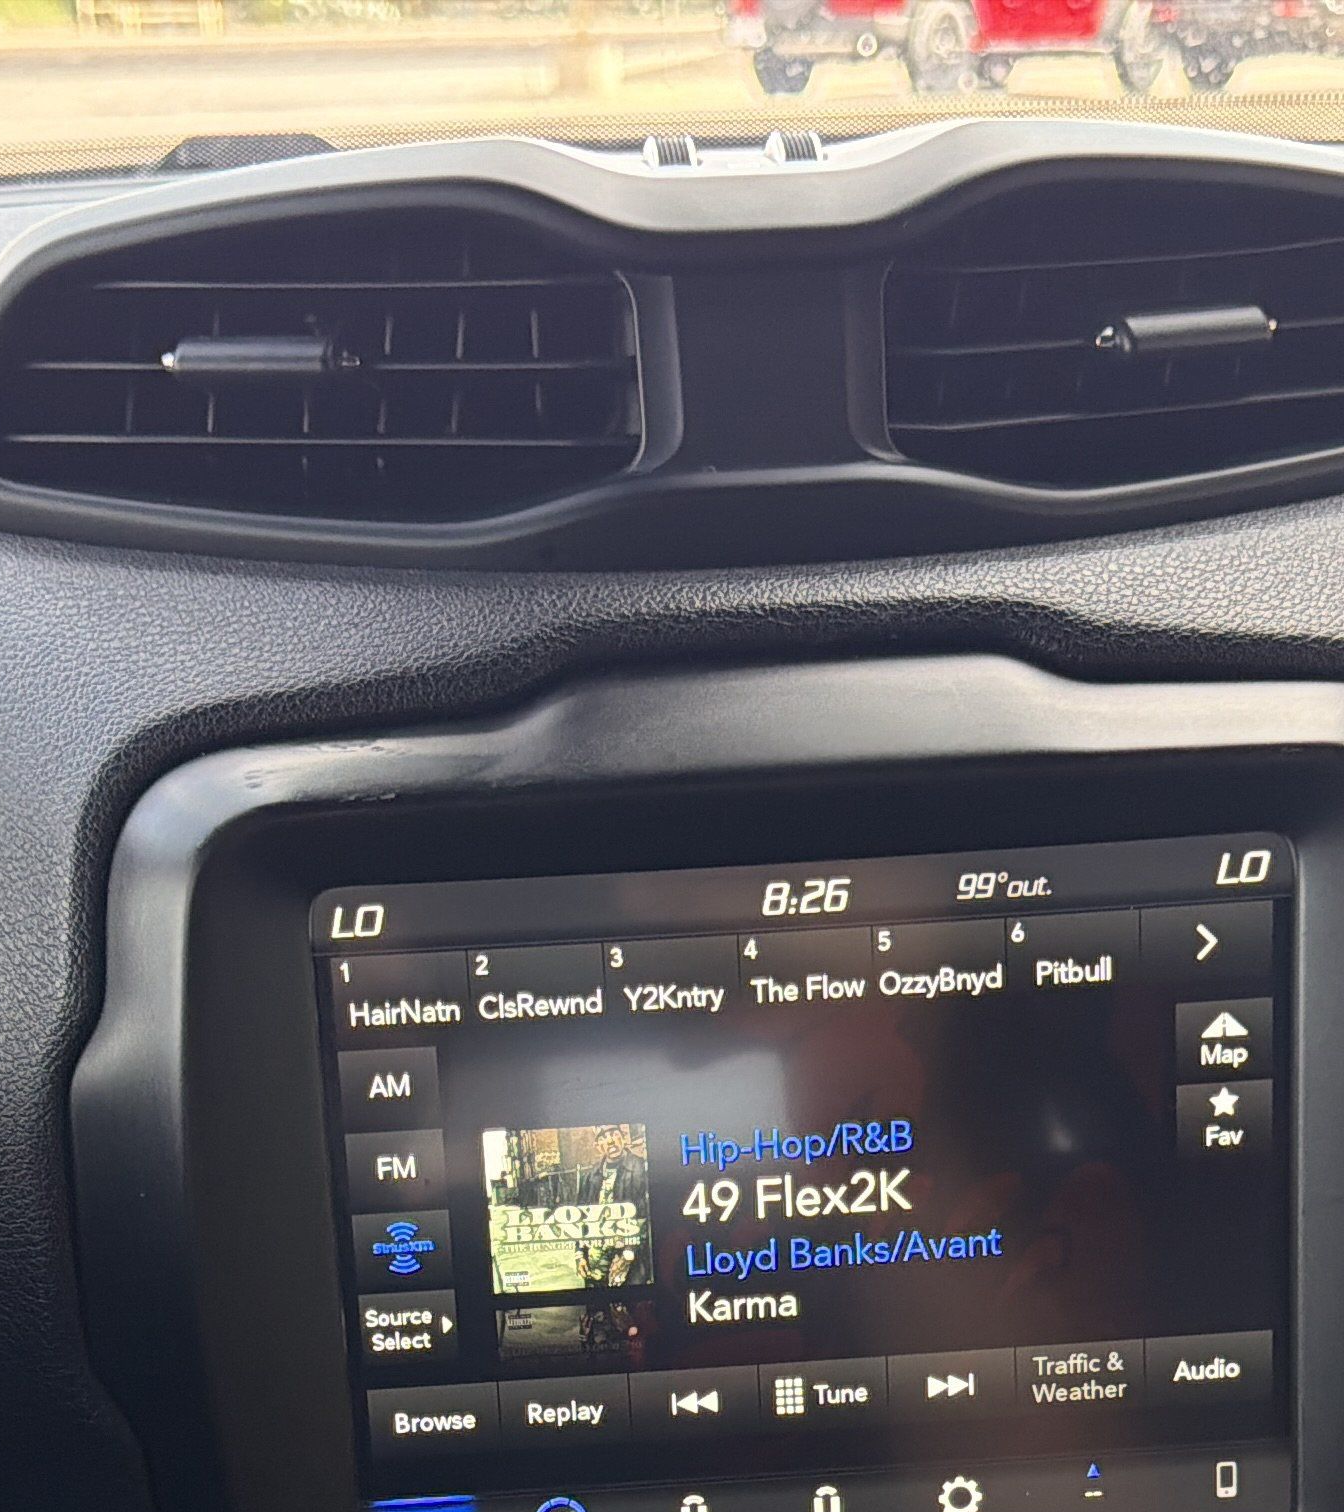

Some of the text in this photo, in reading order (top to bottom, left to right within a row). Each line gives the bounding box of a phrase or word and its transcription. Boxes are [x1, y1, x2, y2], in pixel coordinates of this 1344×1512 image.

[1216, 849, 1272, 885] LO
[762, 878, 851, 916] 8:26
[330, 904, 384, 939] LO
[1011, 922, 1026, 944] 6
[743, 939, 759, 960] 4
[877, 931, 892, 952] 5
[474, 955, 489, 977] 2
[610, 948, 624, 969] 3
[1036, 955, 1113, 986] Pitbull
[339, 962, 351, 983] 1
[879, 963, 1003, 999] OzzyBnyd
[623, 986, 725, 1014] Y2Kntry
[750, 974, 865, 1004] The Flow
[349, 1001, 461, 1027] HairNatn
[478, 989, 604, 1020] ClsRewnd
[1200, 1044, 1249, 1069] Map
[369, 1072, 411, 1099] AM
[681, 1120, 914, 1171] Hip-Hop/R&B
[1205, 1125, 1244, 1147] Fav
[376, 1155, 417, 1181] FM
[682, 1169, 913, 1223] 49 Flex2K
[506, 1201, 638, 1228] LLOYD
[686, 1228, 1003, 1281] Lloyd Banks/Avant
[364, 1309, 433, 1328] Source
[688, 1290, 798, 1324] Karma
[371, 1331, 432, 1352] Select
[1032, 1351, 1125, 1377] Traffic &
[1173, 1357, 1241, 1382] Audio
[813, 1383, 869, 1406] Tune
[1032, 1380, 1128, 1404] Weather
[394, 1411, 477, 1435] Browse
[527, 1401, 605, 1428] Replay
